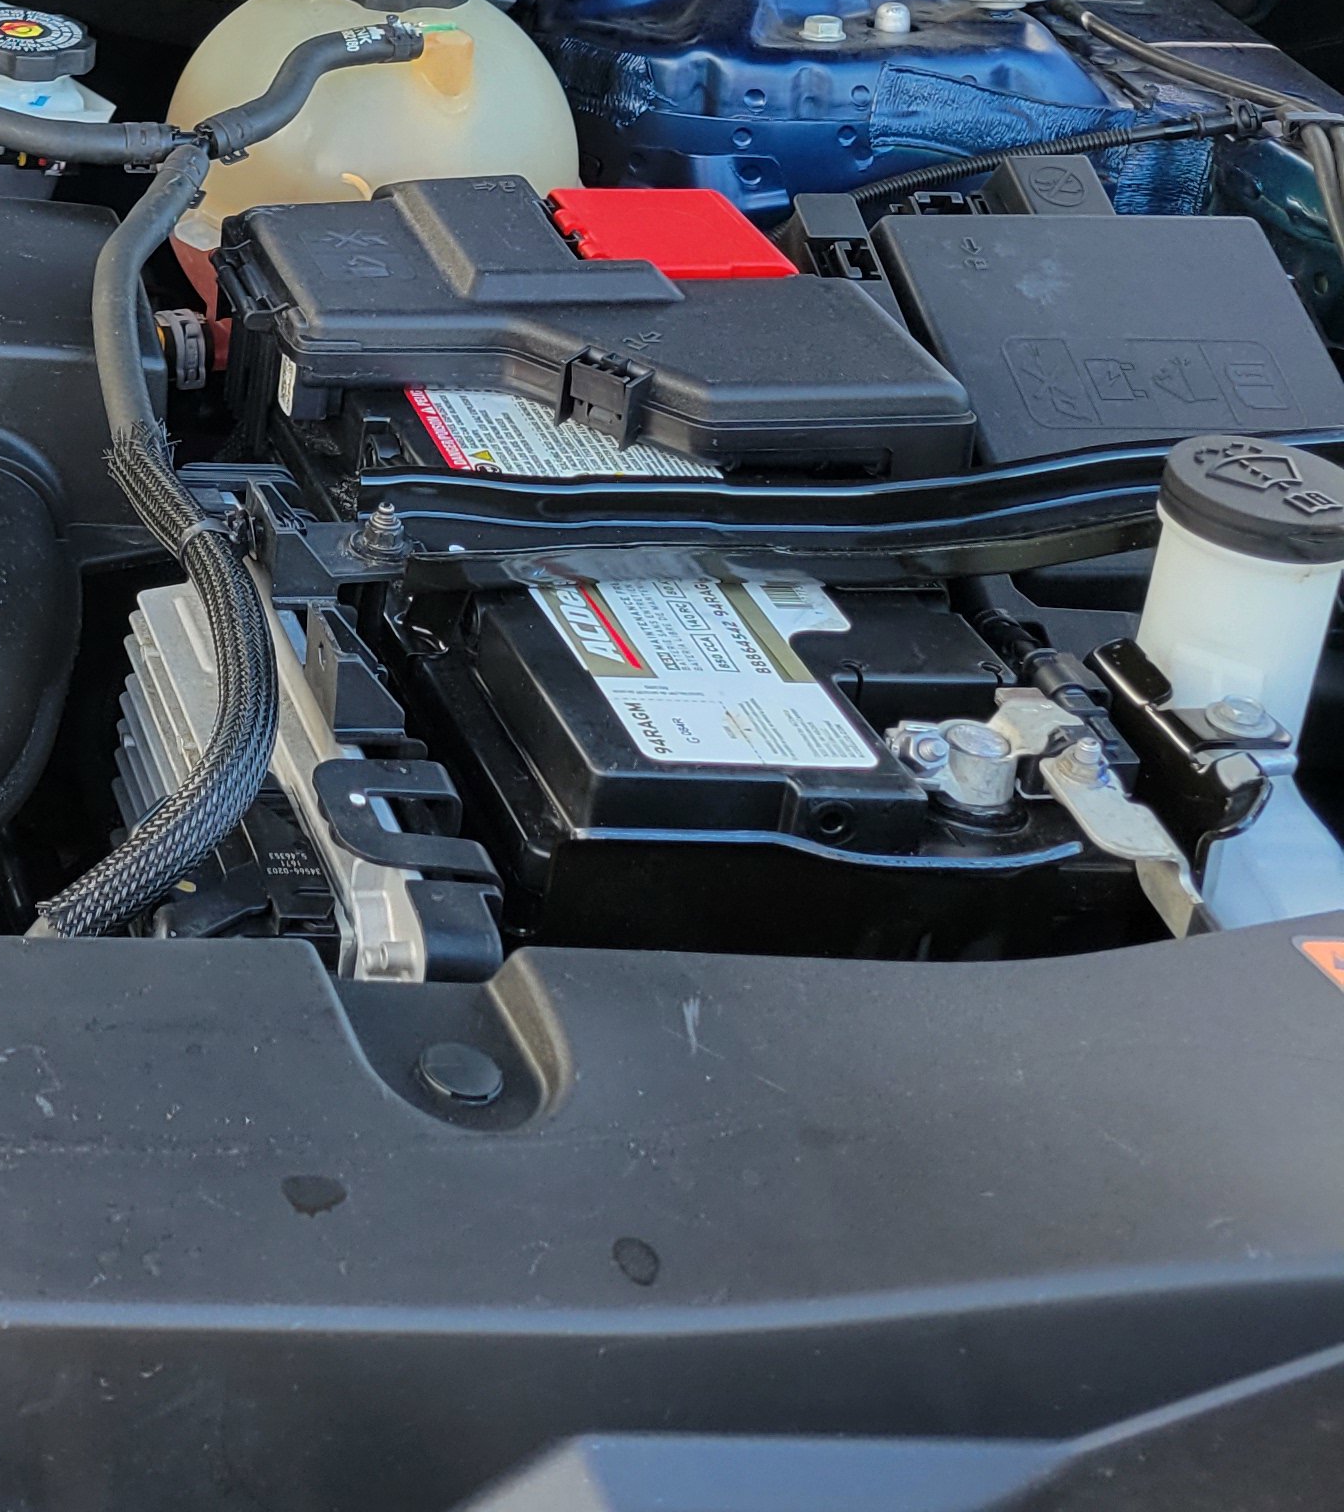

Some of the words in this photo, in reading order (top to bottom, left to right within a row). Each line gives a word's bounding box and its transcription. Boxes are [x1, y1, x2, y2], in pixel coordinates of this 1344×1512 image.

[554, 582, 625, 664] ACDe
[620, 596, 665, 650] MAINTENANCE
[676, 603, 691, 614] RC
[684, 614, 702, 628] 140
[701, 637, 719, 653] CCA
[712, 654, 730, 668] 850
[722, 620, 771, 674] 88864542
[624, 702, 673, 754] 94RAGM
